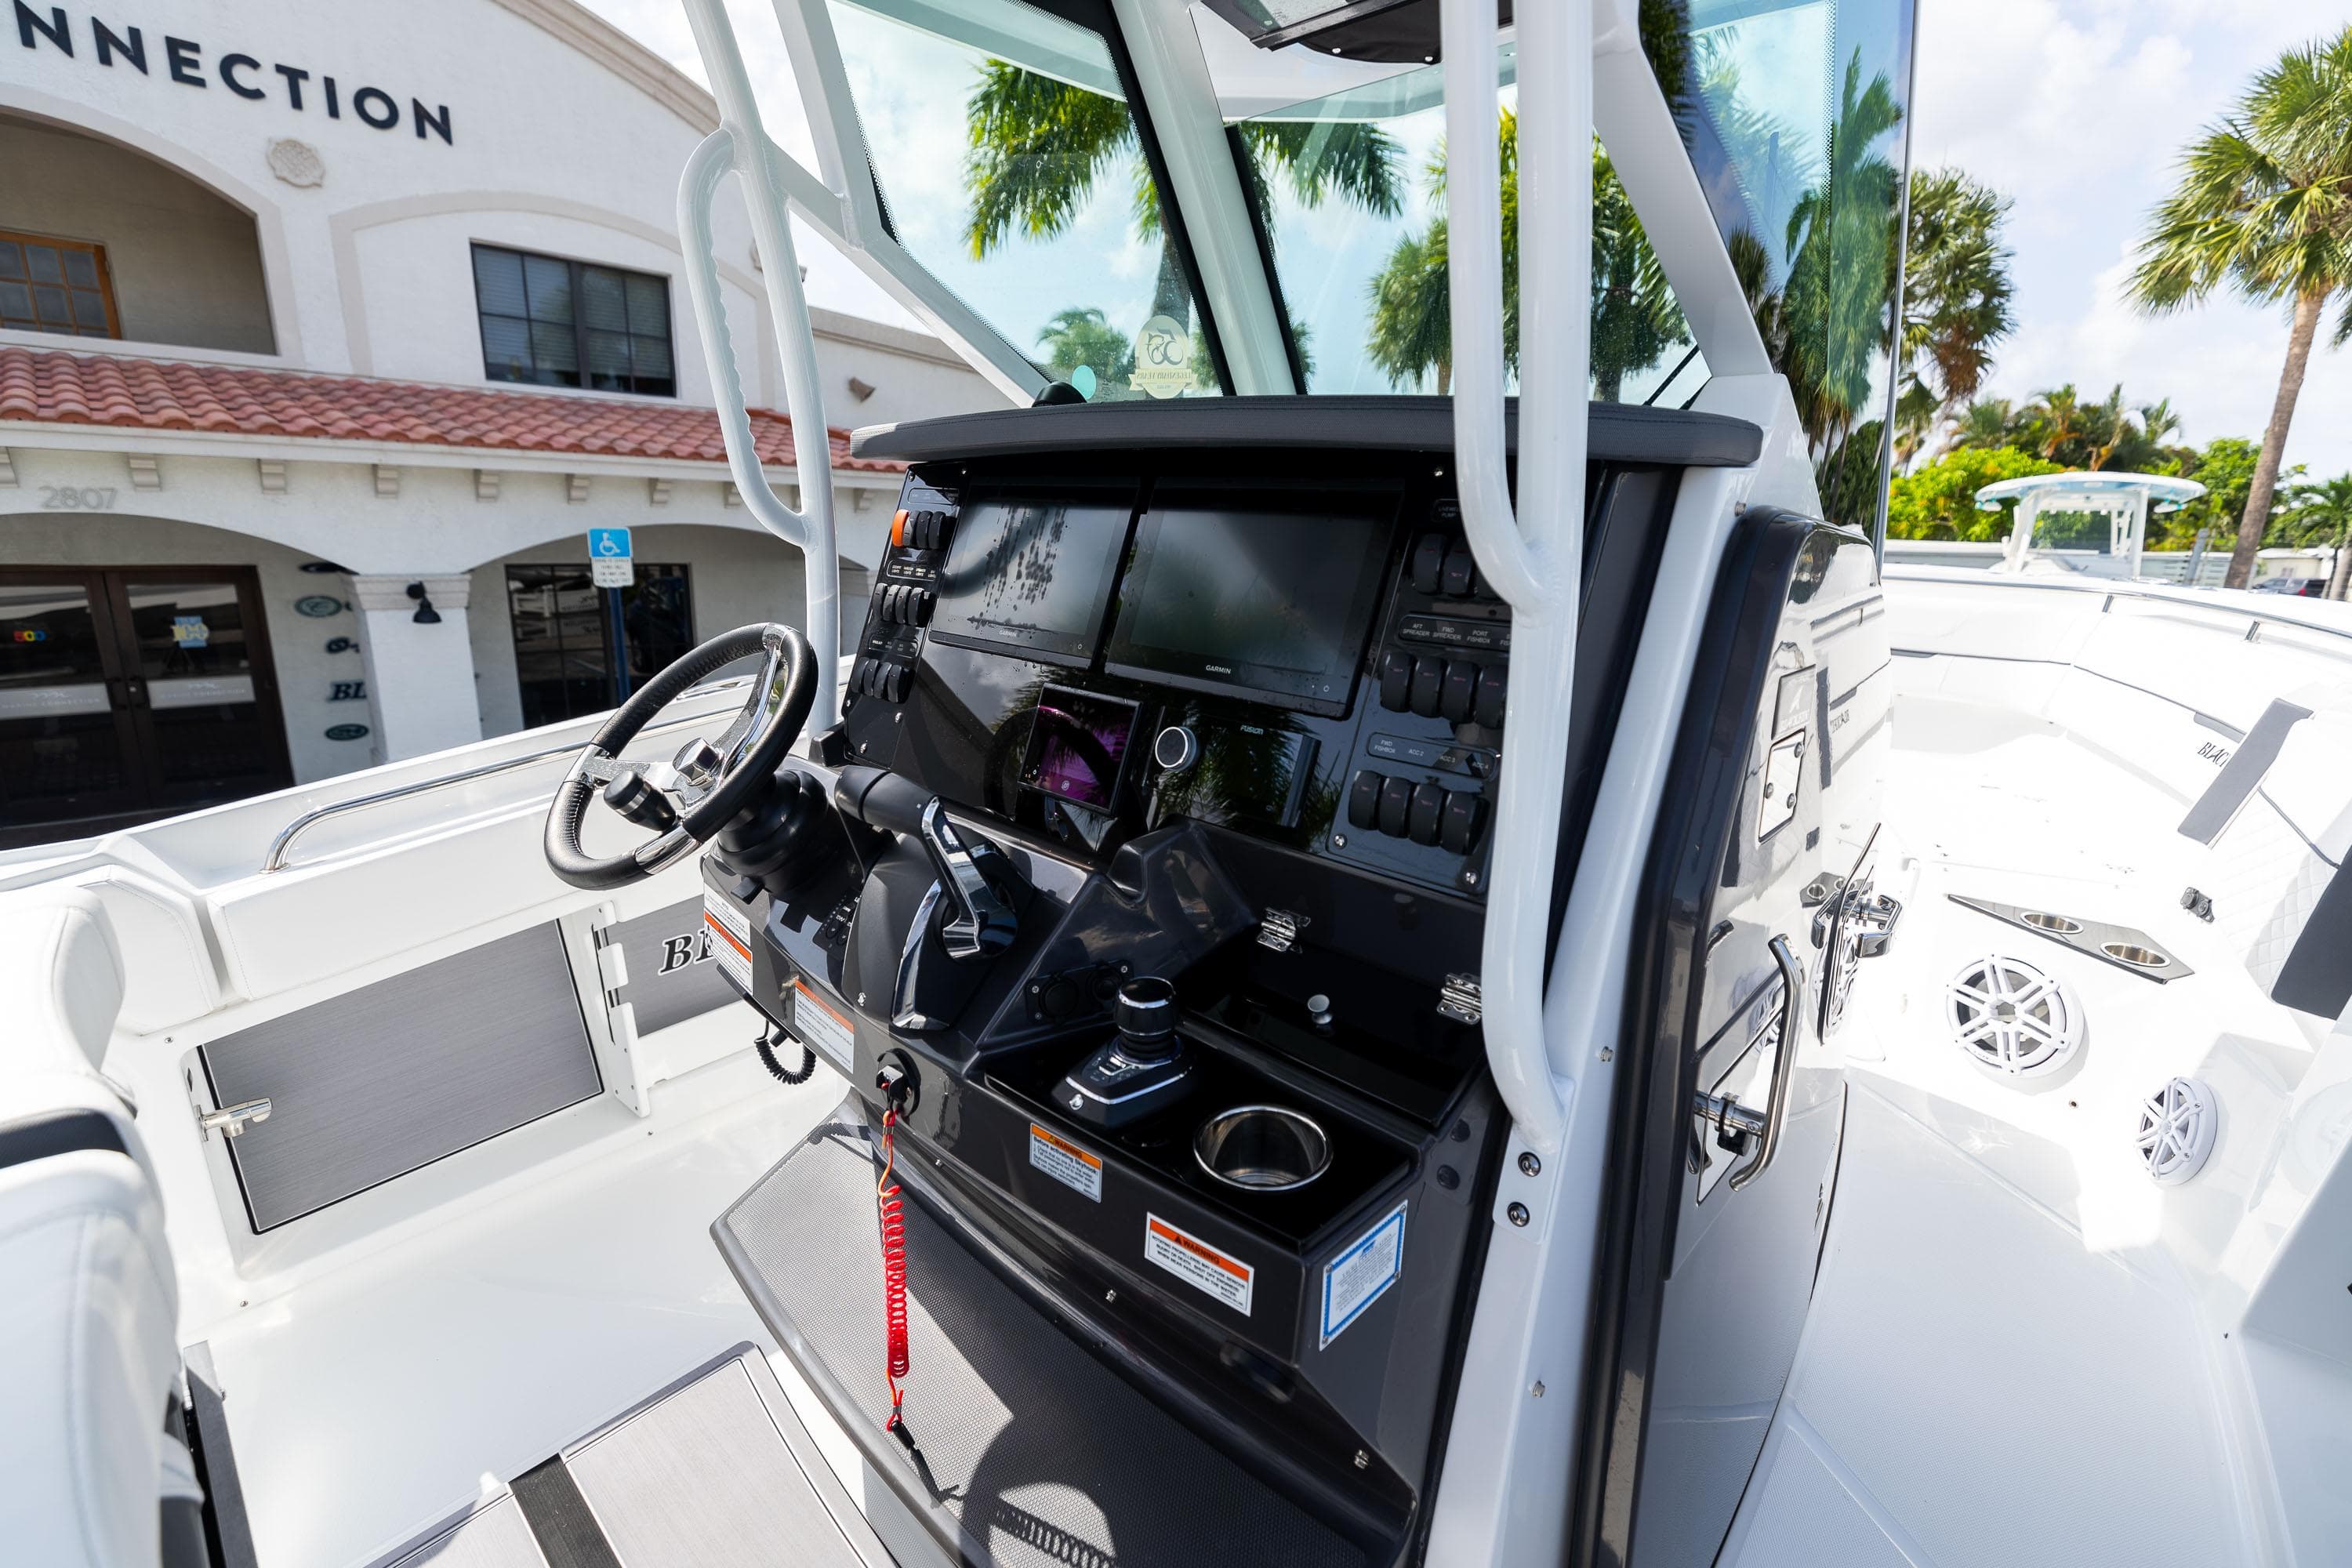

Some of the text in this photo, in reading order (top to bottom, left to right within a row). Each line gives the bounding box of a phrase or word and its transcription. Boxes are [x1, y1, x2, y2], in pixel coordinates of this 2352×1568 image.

[38, 485, 118, 509] 2807
[1432, 632, 1461, 641] SPREADER
[1205, 664, 1232, 674] GARMIN
[1374, 745, 1396, 753] FISHBOX
[1033, 1136, 1048, 1149] Before
[1050, 1145, 1073, 1162] activating
[1054, 1138, 1082, 1159] WARNING
[1152, 1235, 1171, 1249] ROTATING
[1201, 1261, 1210, 1270] MAY
[1210, 1267, 1225, 1278] CAUSE
[1156, 1243, 1171, 1255] INJURY
[1193, 1264, 1205, 1274] SHUT
[1183, 1239, 1219, 1264] WARNING
[1157, 1250, 1169, 1260] WHEN
[1171, 1258, 1181, 1268] NEAR
[1183, 1265, 1203, 1279] PERSONS
